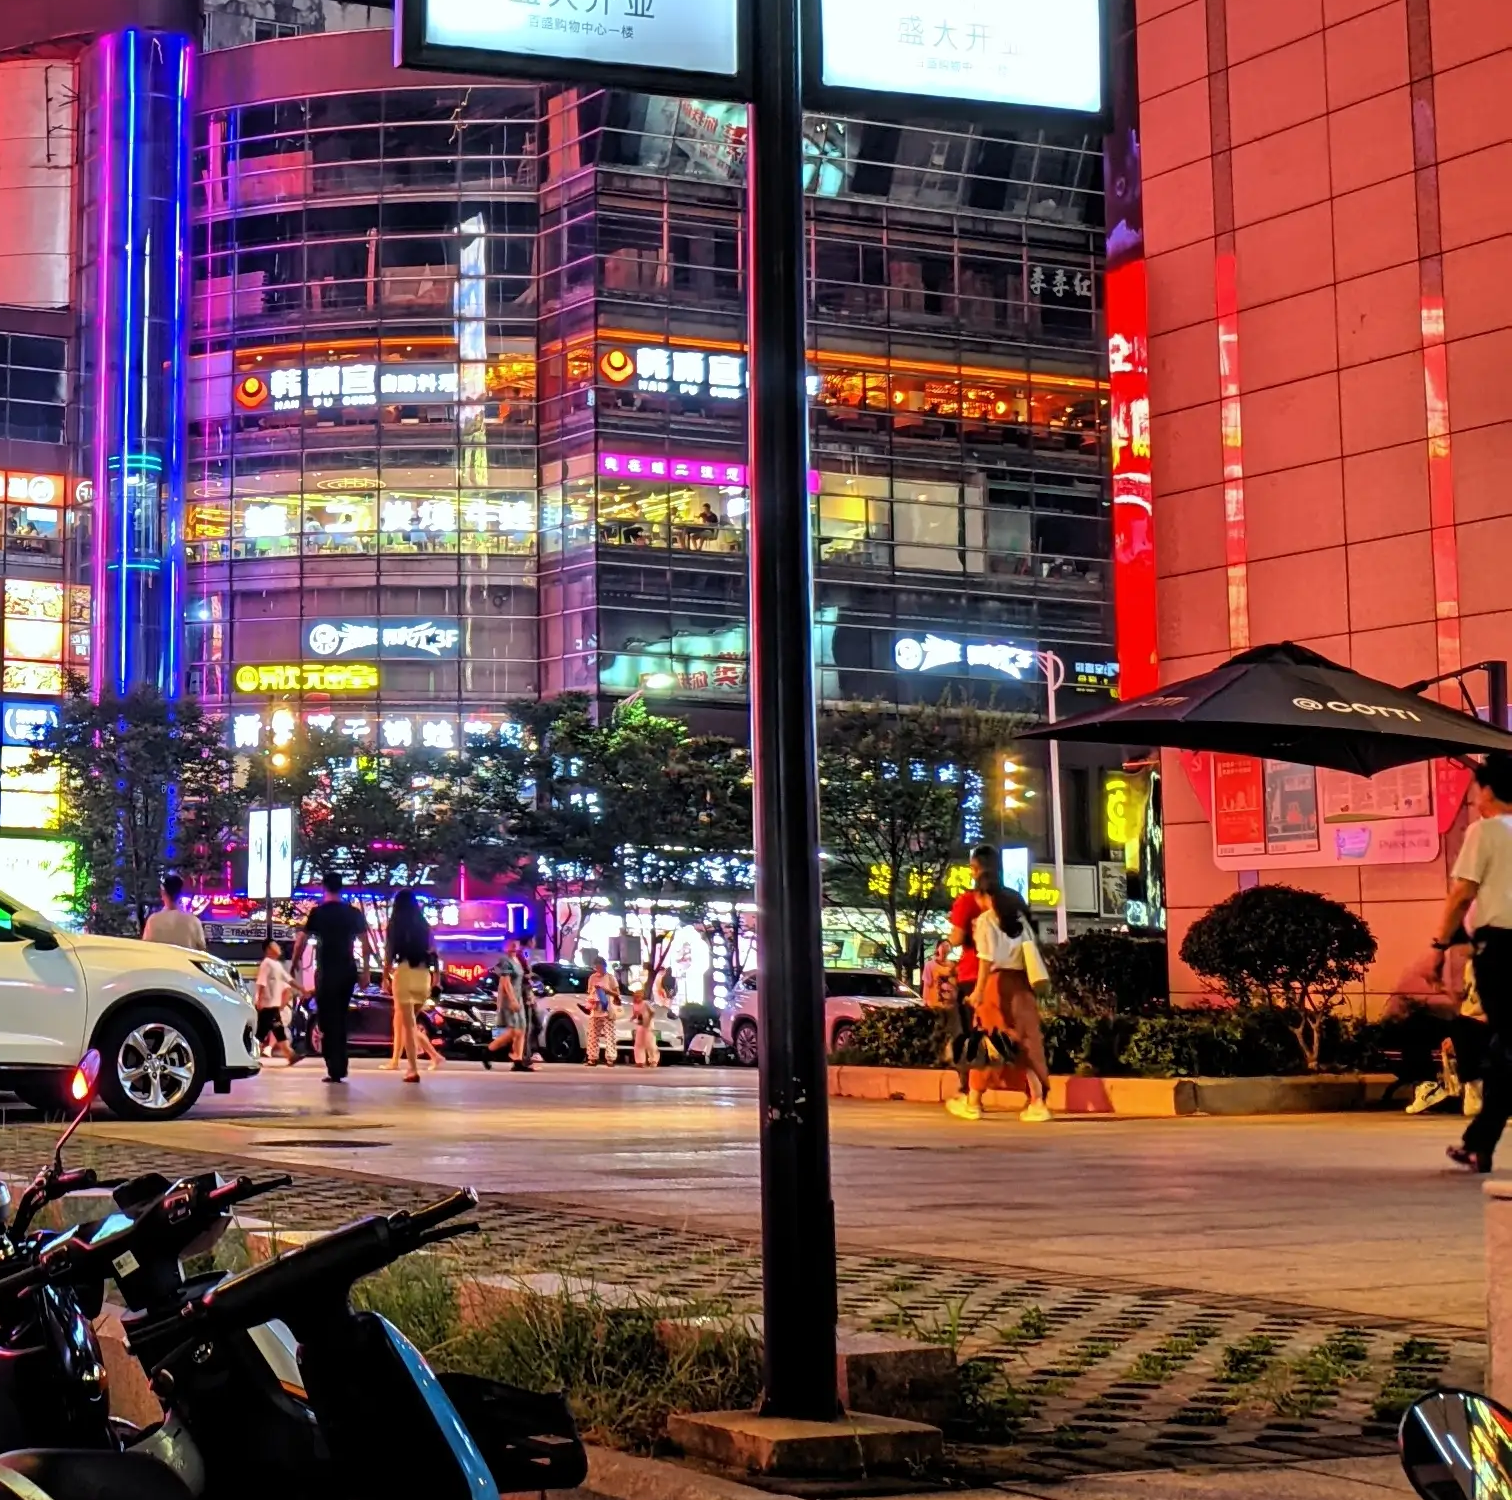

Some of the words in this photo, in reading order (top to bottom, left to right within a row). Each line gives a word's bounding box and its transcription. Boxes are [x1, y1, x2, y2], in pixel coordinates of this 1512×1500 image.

[528, 13, 635, 40] 百盛购物中心一楼
[1326, 700, 1422, 723] COTTI
